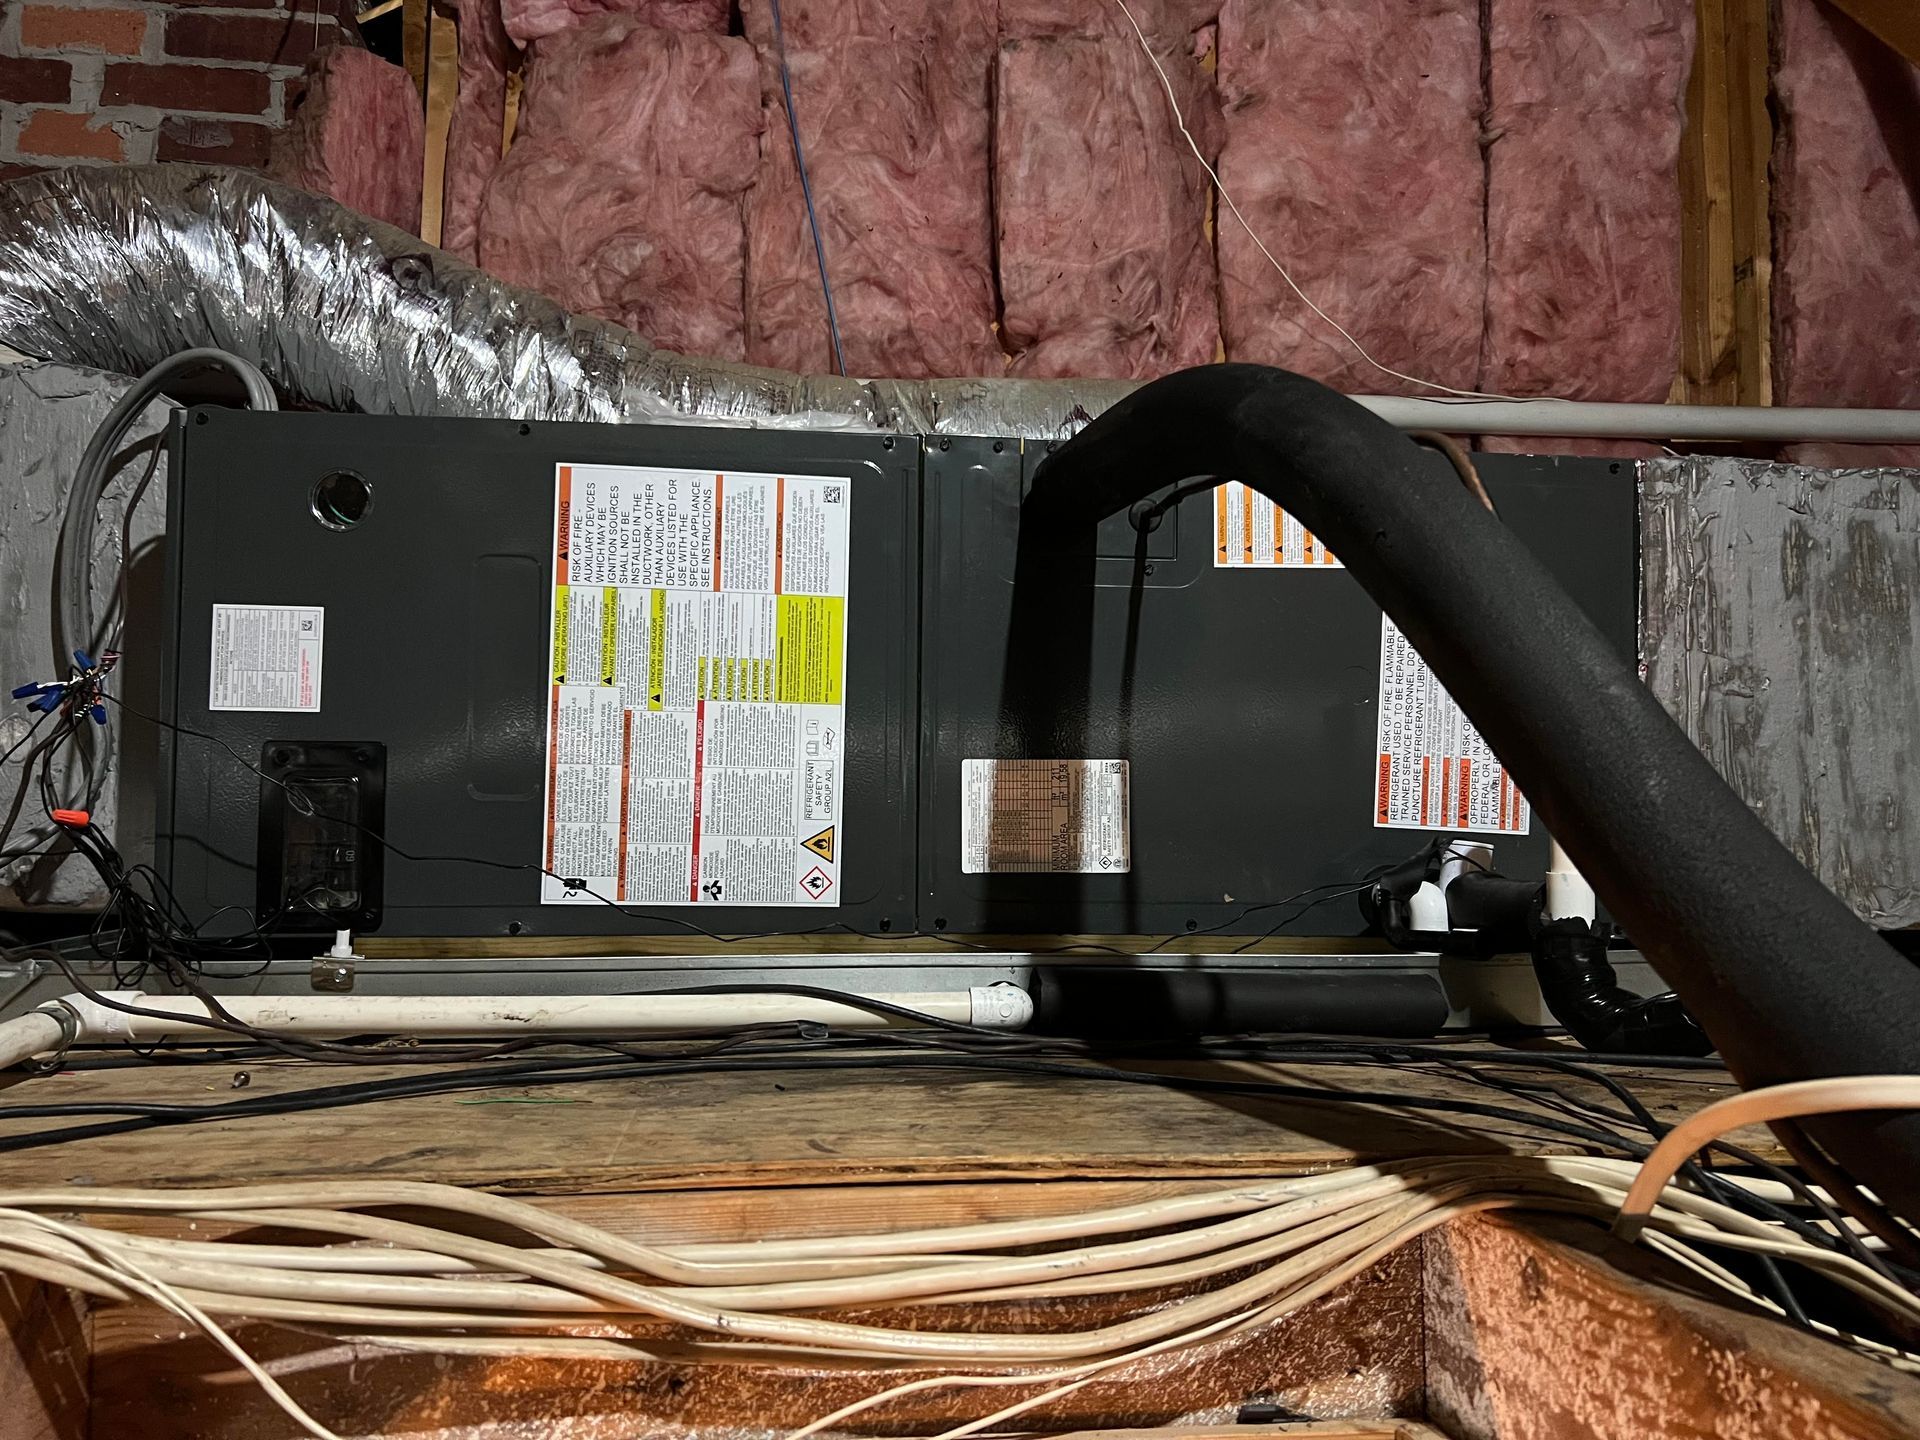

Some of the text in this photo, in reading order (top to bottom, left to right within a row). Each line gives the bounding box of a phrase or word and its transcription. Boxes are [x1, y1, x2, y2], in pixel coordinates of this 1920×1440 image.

[620, 510, 630, 524] BE
[644, 483, 655, 519] OTHER
[559, 500, 570, 549] WARNING
[572, 514, 582, 538] FIRE
[582, 482, 595, 583] AUXILIARY DEVICES
[594, 507, 606, 583] WHICH MAY BE
[606, 485, 619, 584] IGNITION SOURCES
[619, 527, 629, 548] NOT
[630, 492, 642, 585] INSTALLED IN THE
[653, 502, 665, 585] THAN AUXILIARY
[665, 478, 678, 586] DEVICES LISTED FOR
[572, 541, 581, 555] OF
[618, 552, 628, 584] SHALL
[677, 513, 688, 586] USE WITH THE
[689, 540, 699, 587] SPECIFIC
[571, 557, 581, 582] RISK
[700, 566, 710, 587] SEE
[658, 614, 664, 622] LA
[601, 642, 609, 676] ATTENTION
[656, 658, 663, 666] DE
[1407, 651, 1415, 666] DO
[1381, 625, 1395, 751] RISK OF FIRE. FLAMMABLE
[1404, 671, 1414, 730] PERSONNEL.
[1389, 635, 1406, 820] REFRIGERANT USED. TO BE REPAIRED
[1413, 696, 1424, 765] REFRIGERANT
[1461, 733, 1470, 755] RISK
[1402, 734, 1412, 775] SERVICE
[1472, 746, 1480, 755] IN
[1481, 763, 1490, 777] OR
[804, 760, 815, 818] REFRIGERANT
[814, 773, 823, 806] SAFETY
[1051, 767, 1059, 780] 211
[1379, 761, 1389, 808] WARNING
[1410, 768, 1421, 821] PUNCTURE
[1459, 765, 1469, 812] WARNING
[1469, 758, 1480, 824] OFPROPERLY
[823, 784, 832, 813] GROUP
[1400, 778, 1410, 820] TRAINED
[1479, 780, 1489, 824] FEDERAL
[1490, 767, 1500, 825] FLAMMABLE
[1051, 834, 1059, 870] MINIMUM
